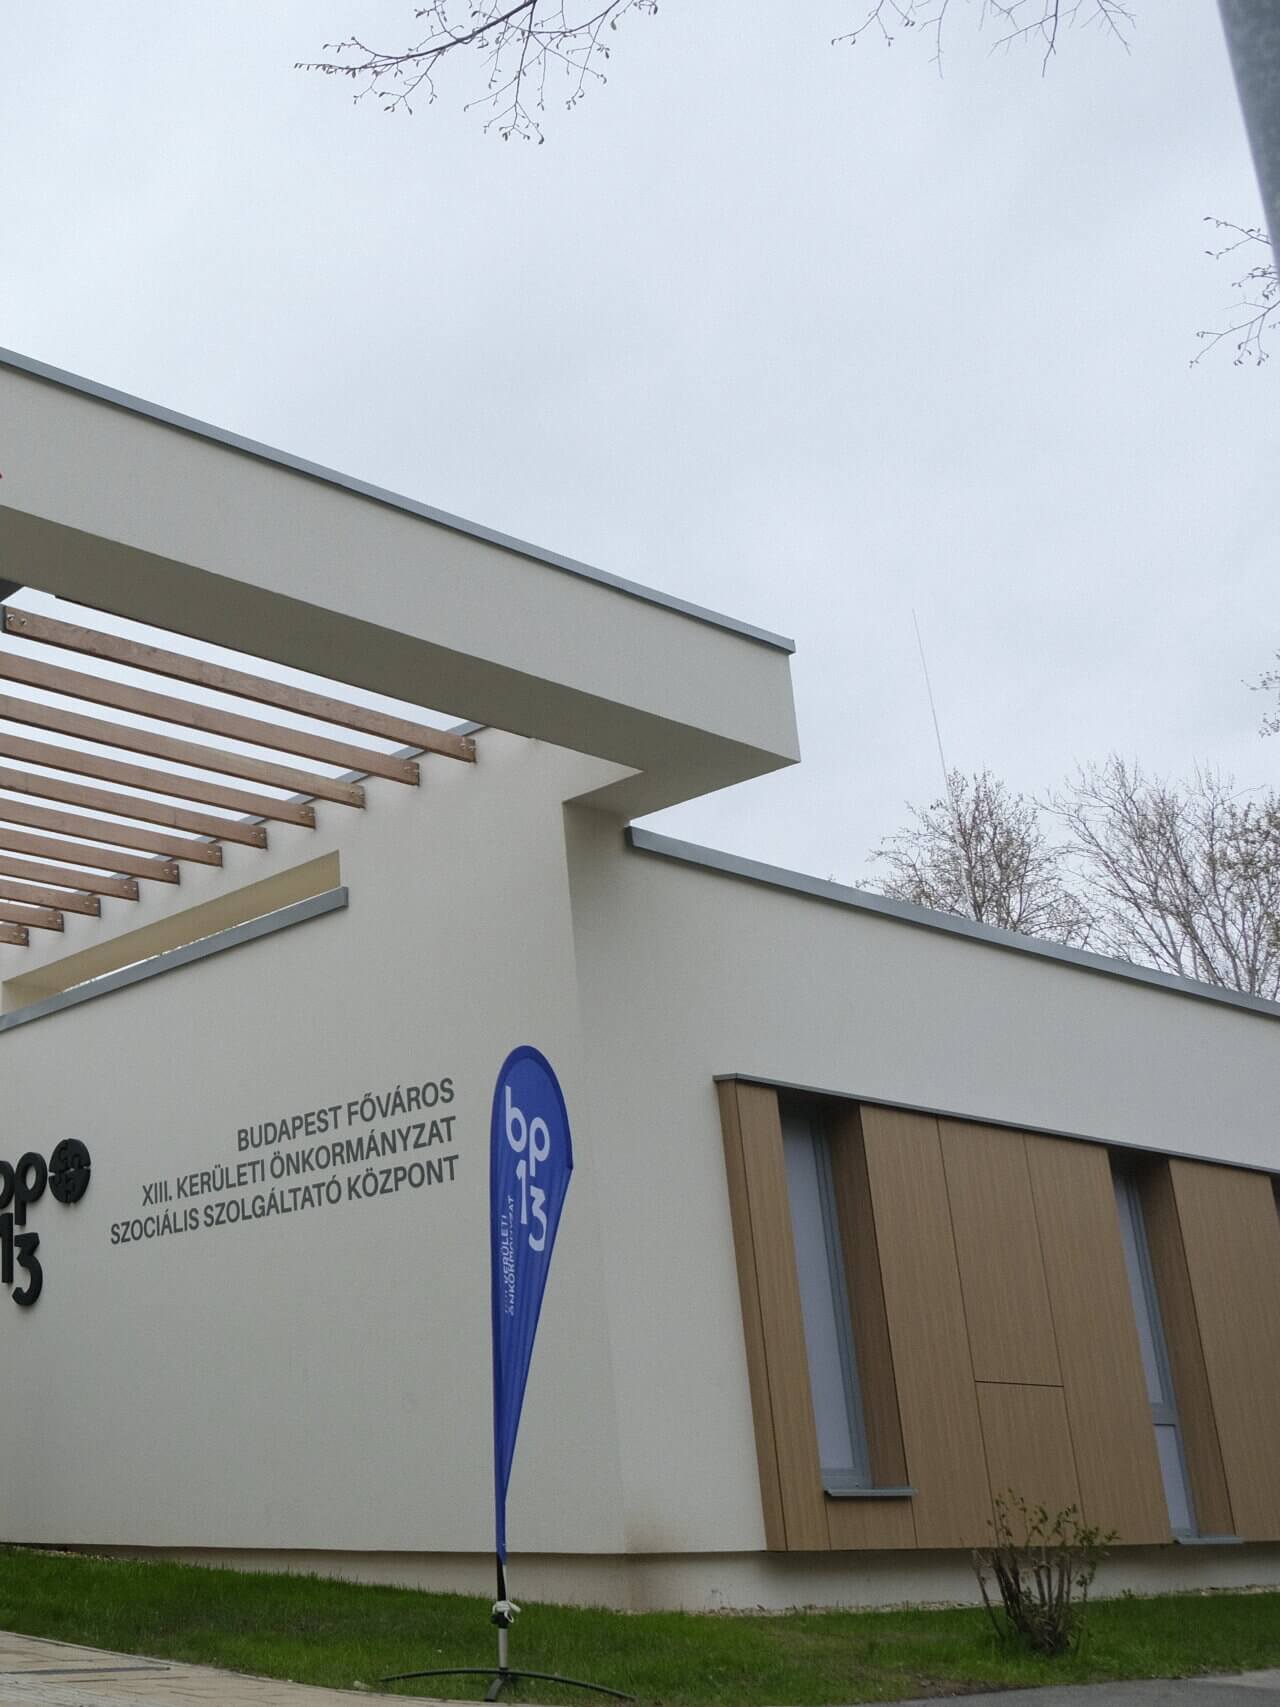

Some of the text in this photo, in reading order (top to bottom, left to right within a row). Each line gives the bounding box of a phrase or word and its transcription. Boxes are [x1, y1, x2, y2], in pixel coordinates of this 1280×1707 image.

[237, 1077, 454, 1151] BUDAPEST FŐVÁROS
[505, 1085, 550, 1177] bp
[110, 1154, 460, 1245] SZOCIÁLIS SZOLGÁLTATÓ KÖZPONT
[141, 1116, 456, 1206] XIII. KERÜLETI ÖNKORMÁNYZAT
